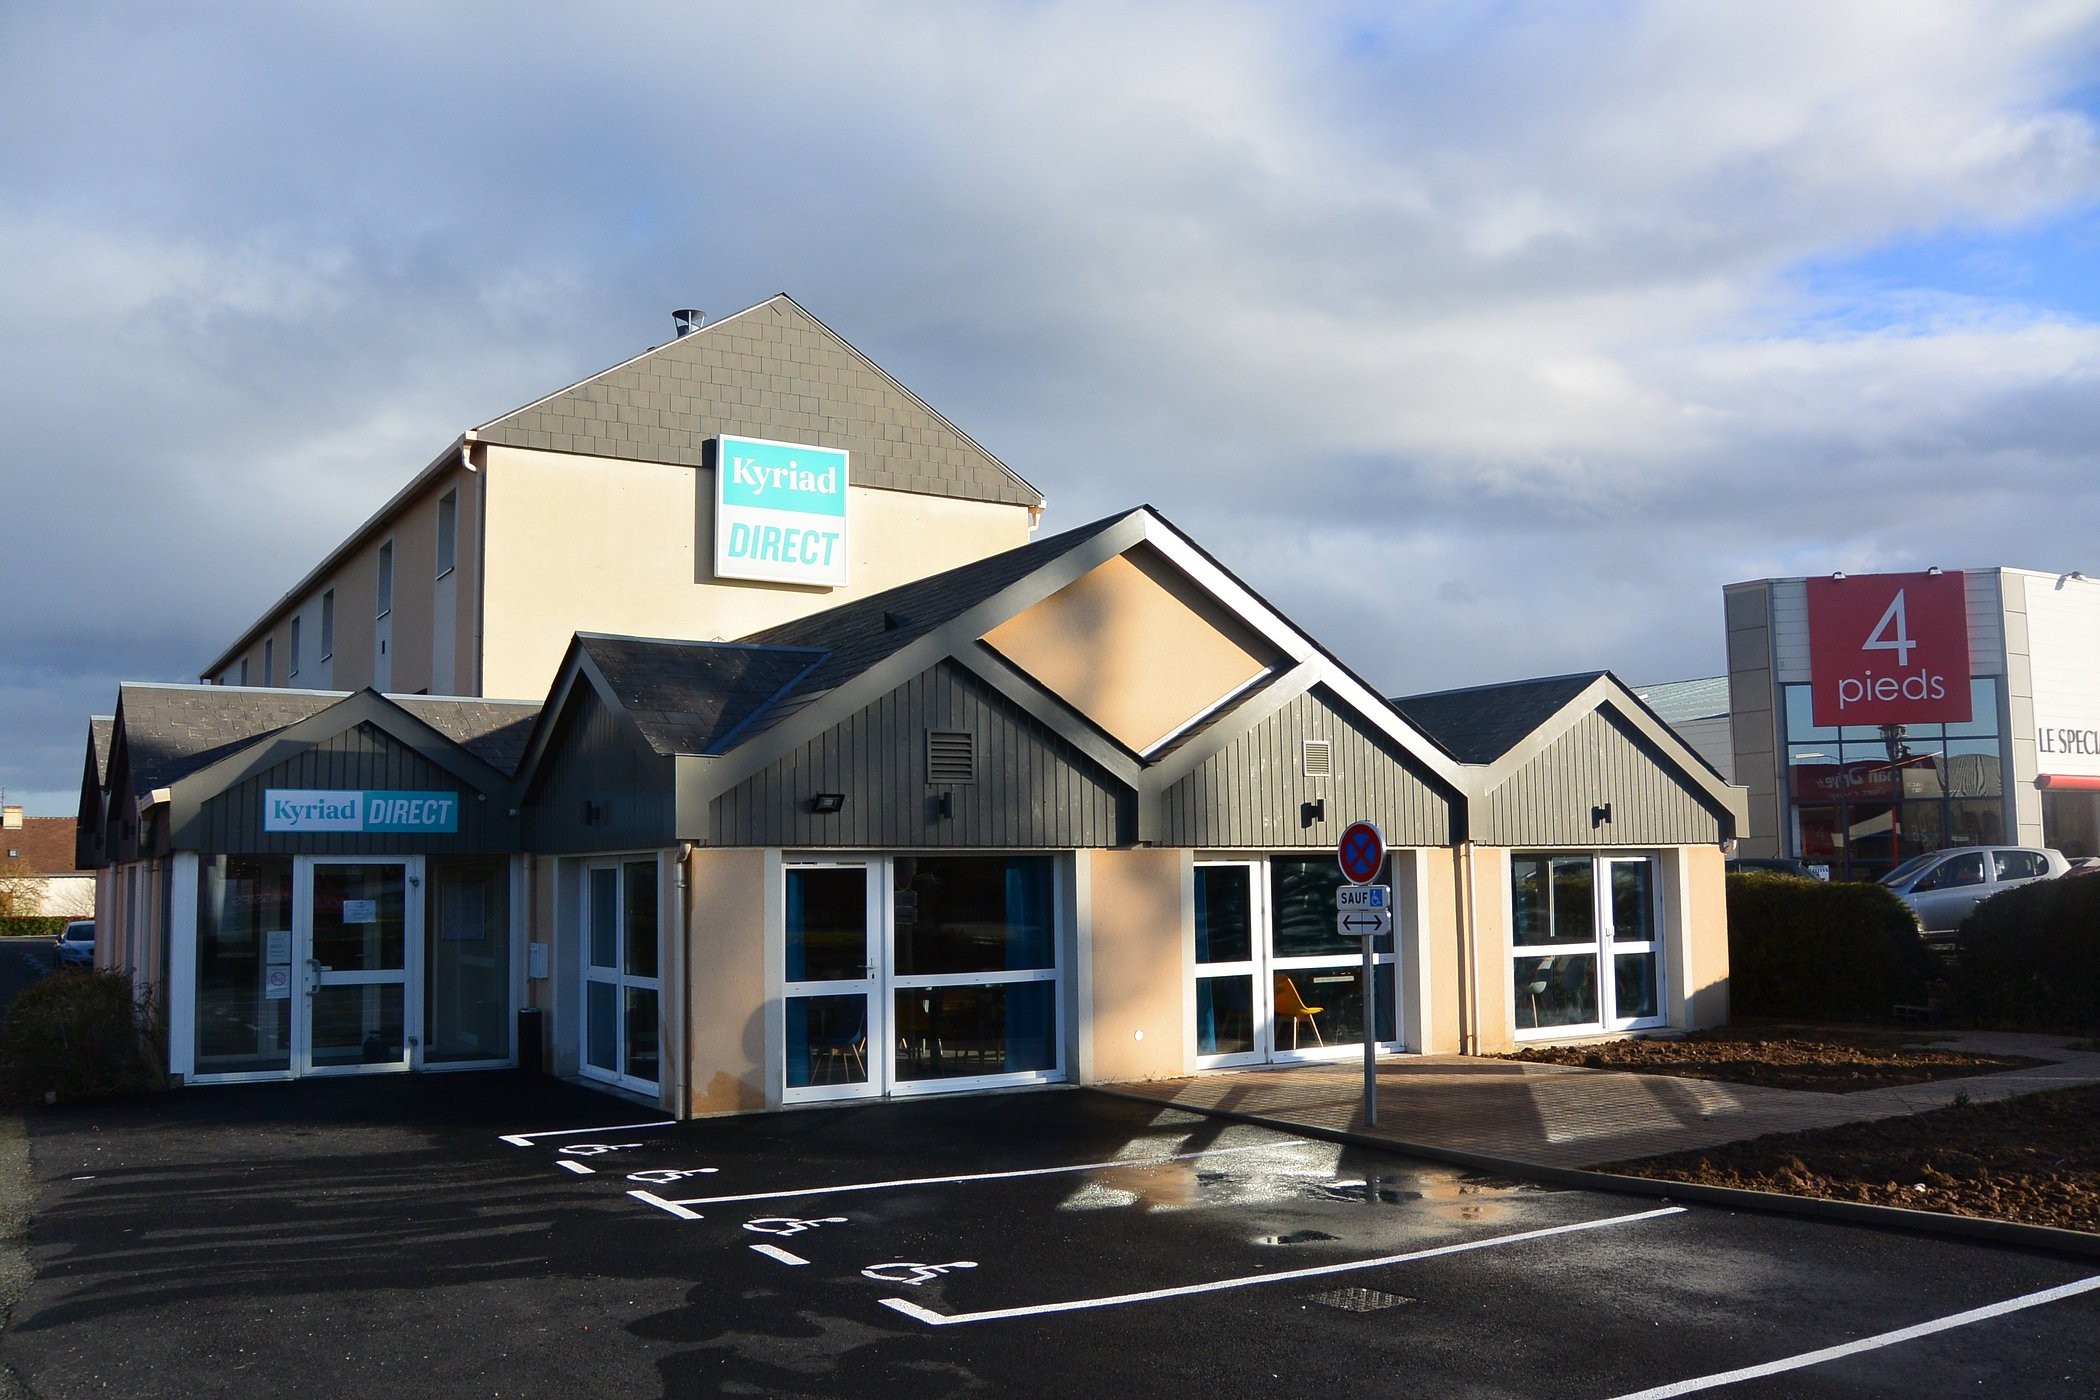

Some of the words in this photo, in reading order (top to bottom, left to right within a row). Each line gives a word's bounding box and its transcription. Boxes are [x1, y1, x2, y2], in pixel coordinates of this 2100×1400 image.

[732, 456, 837, 495] Kyriad
[727, 522, 839, 566] DIRECT
[1861, 587, 1917, 667] 4
[1838, 668, 1946, 710] pieds
[2038, 727, 2055, 753] LE
[273, 798, 356, 826] Kyriad
[368, 799, 453, 825] DIRECT
[1340, 892, 1368, 905] SAUF
